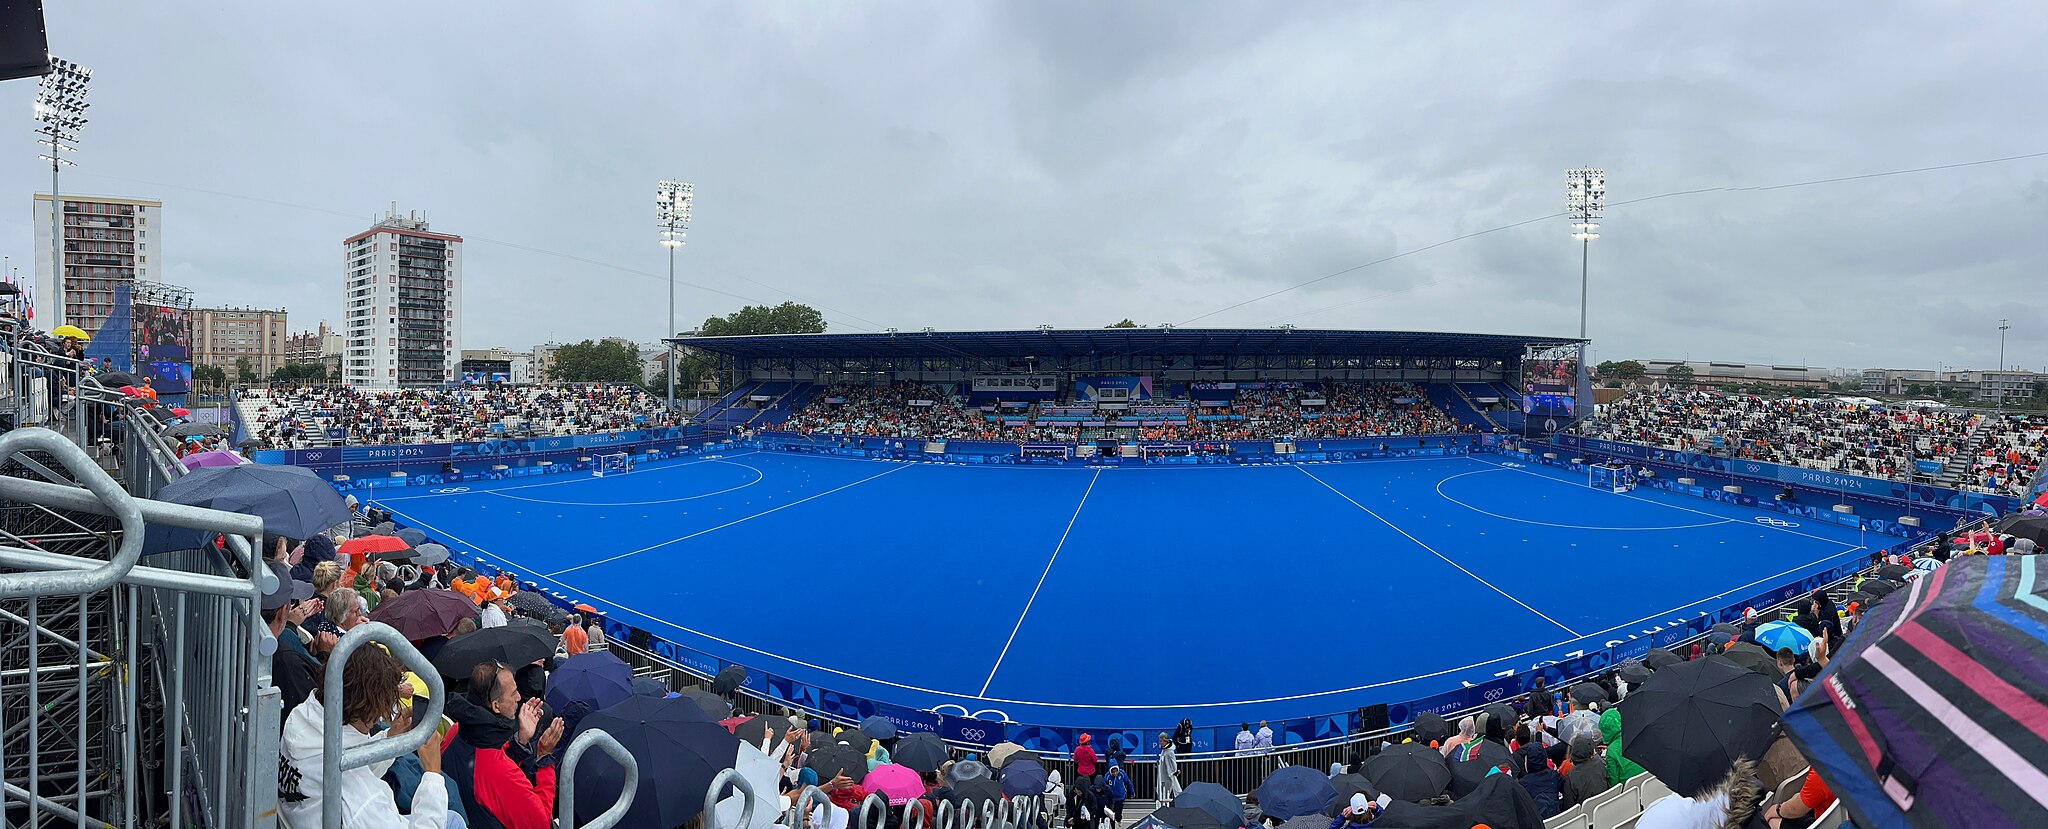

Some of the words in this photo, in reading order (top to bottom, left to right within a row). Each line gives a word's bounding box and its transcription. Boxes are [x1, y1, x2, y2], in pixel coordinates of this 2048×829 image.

[368, 449, 396, 458] PARIS
[399, 447, 424, 456] 2024
[1617, 445, 1634, 454] 2024
[1802, 472, 1831, 484] PARIS
[1834, 477, 1862, 489] 2024
[680, 656, 698, 667] PARIS
[699, 662, 716, 673] 2024
[1441, 701, 1462, 712] 2024
[885, 715, 909, 727] PARIS
[911, 721, 935, 732] 2024
